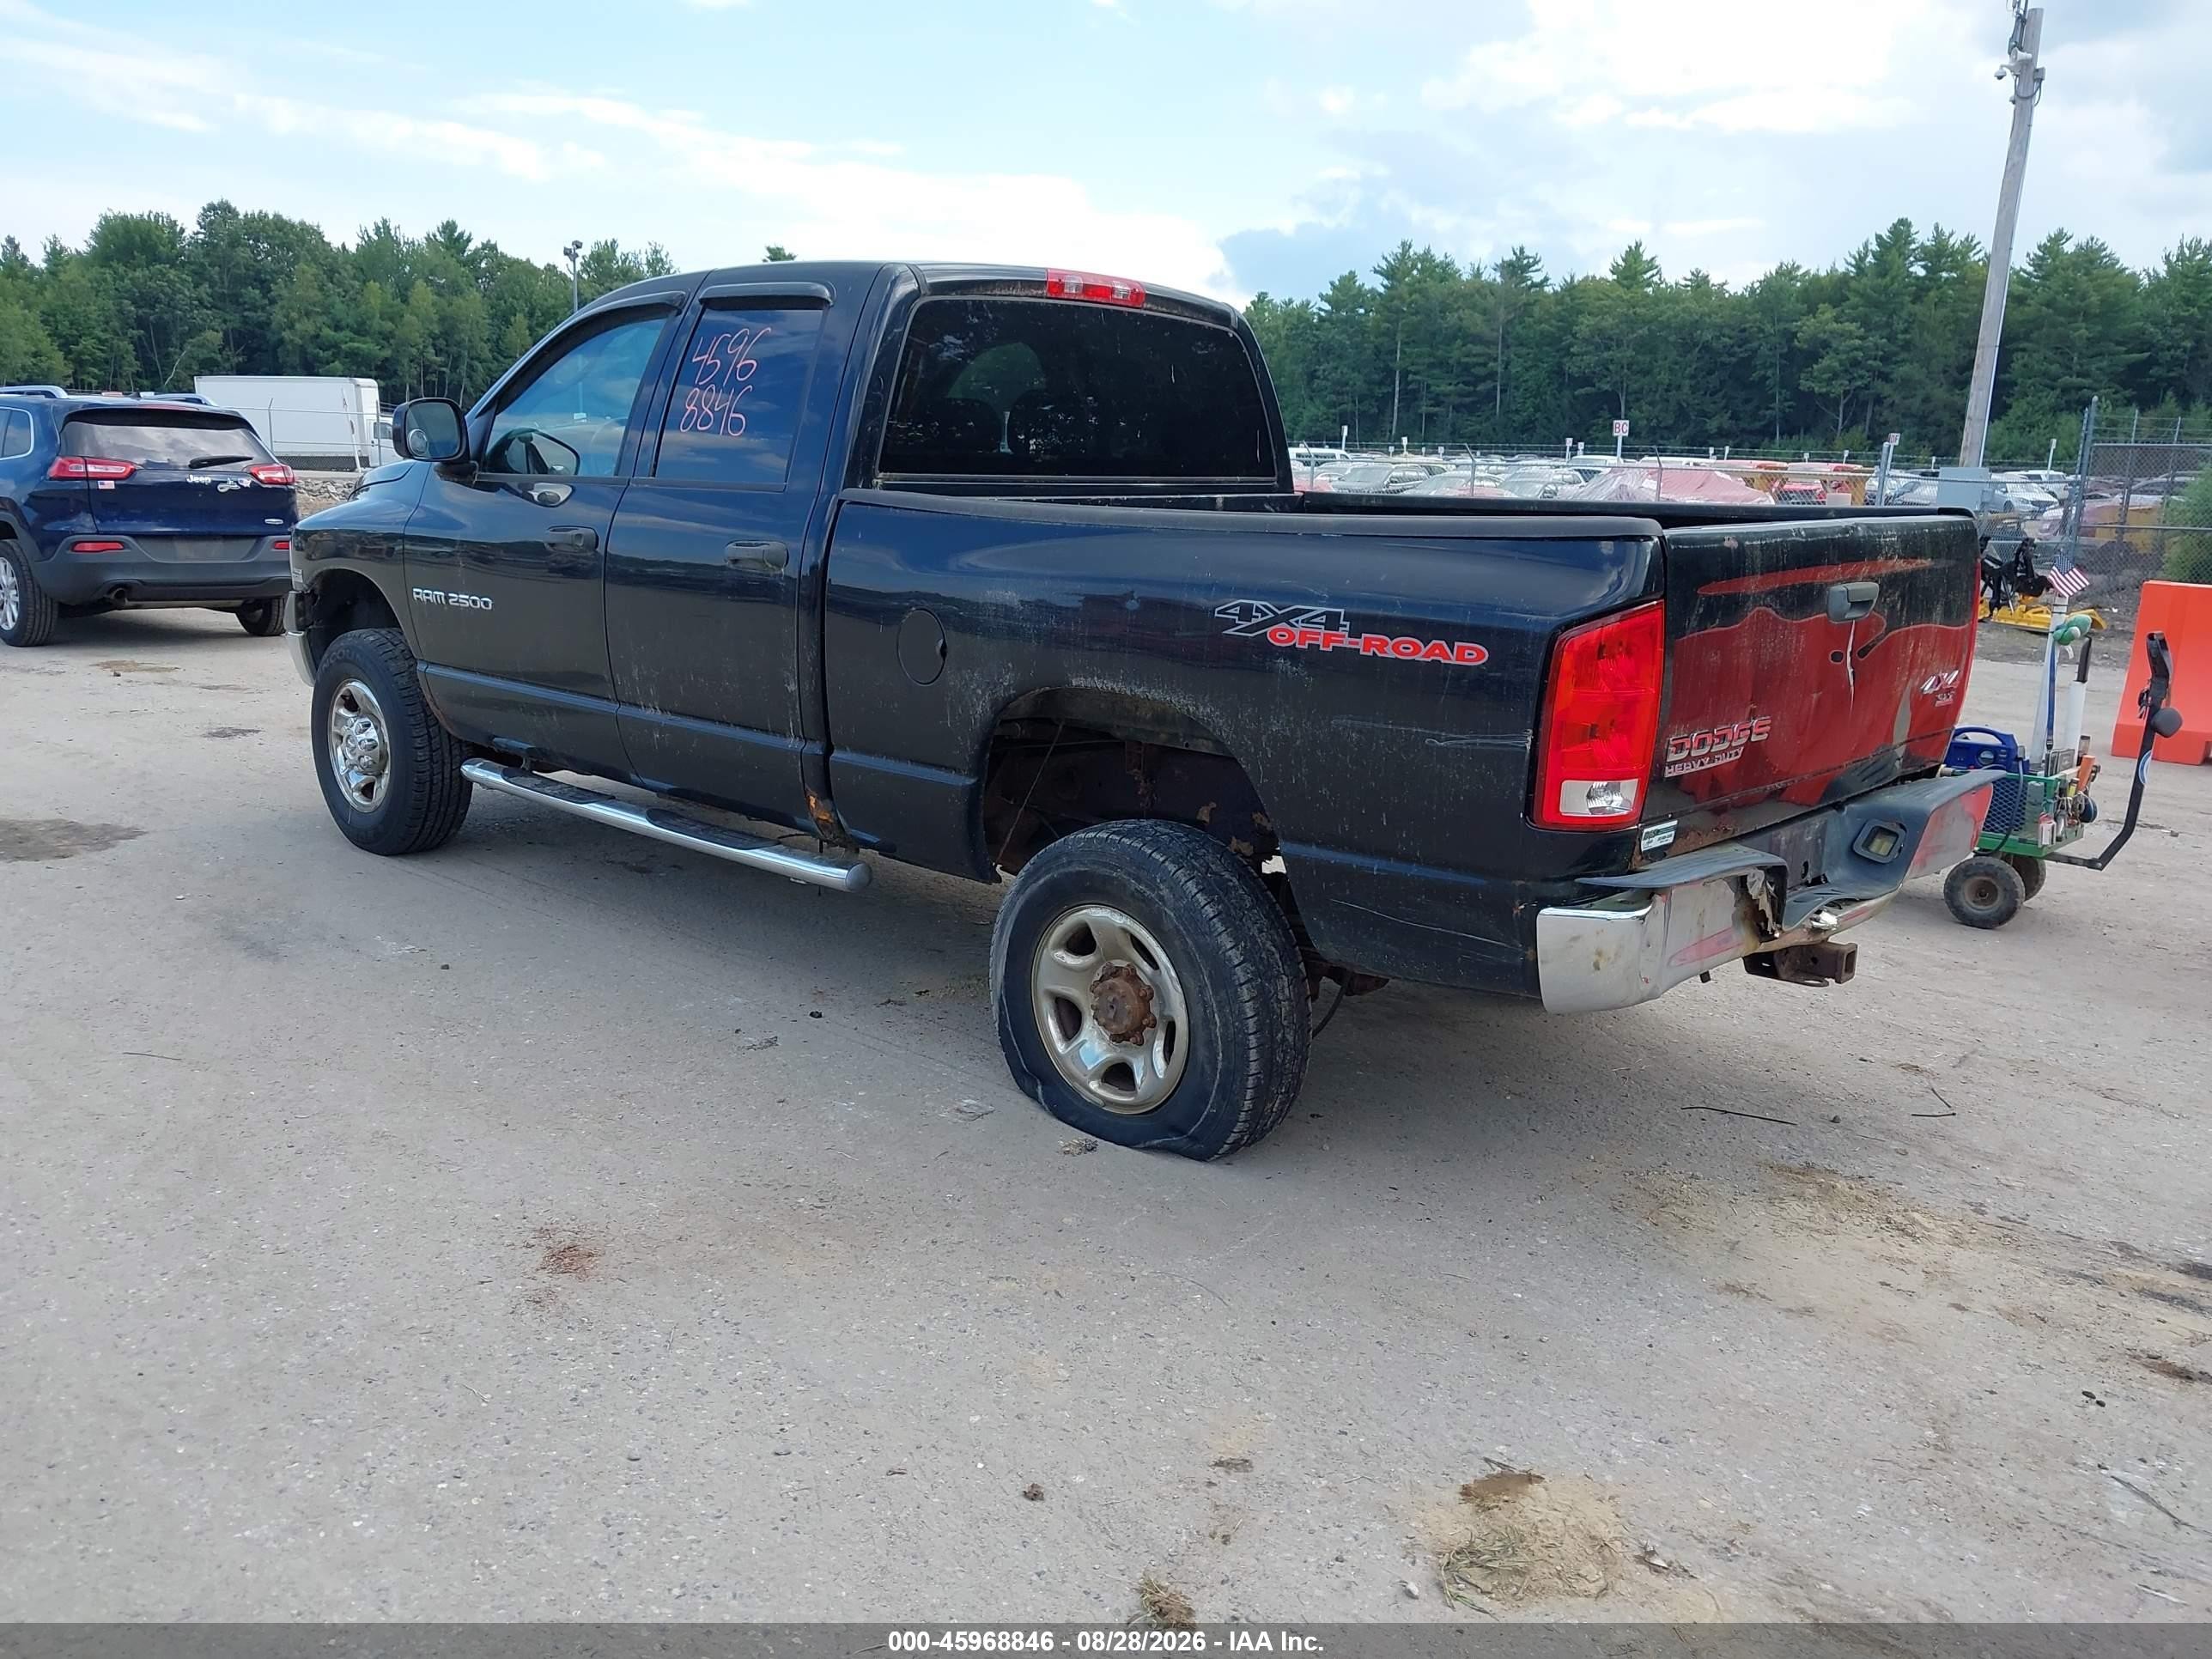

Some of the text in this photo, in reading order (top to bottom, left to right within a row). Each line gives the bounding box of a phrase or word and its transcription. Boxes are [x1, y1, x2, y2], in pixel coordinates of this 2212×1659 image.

[692, 327, 772, 387] 4596
[679, 384, 753, 437] 8846
[1614, 422, 1628, 434] BC
[186, 474, 212, 485] Jeep
[412, 587, 493, 611] RAM 2500
[1267, 626, 1489, 666] OFF-ROAD
[1666, 716, 1772, 763] DODGE
[1664, 747, 1744, 776] HEAVY DUTY
